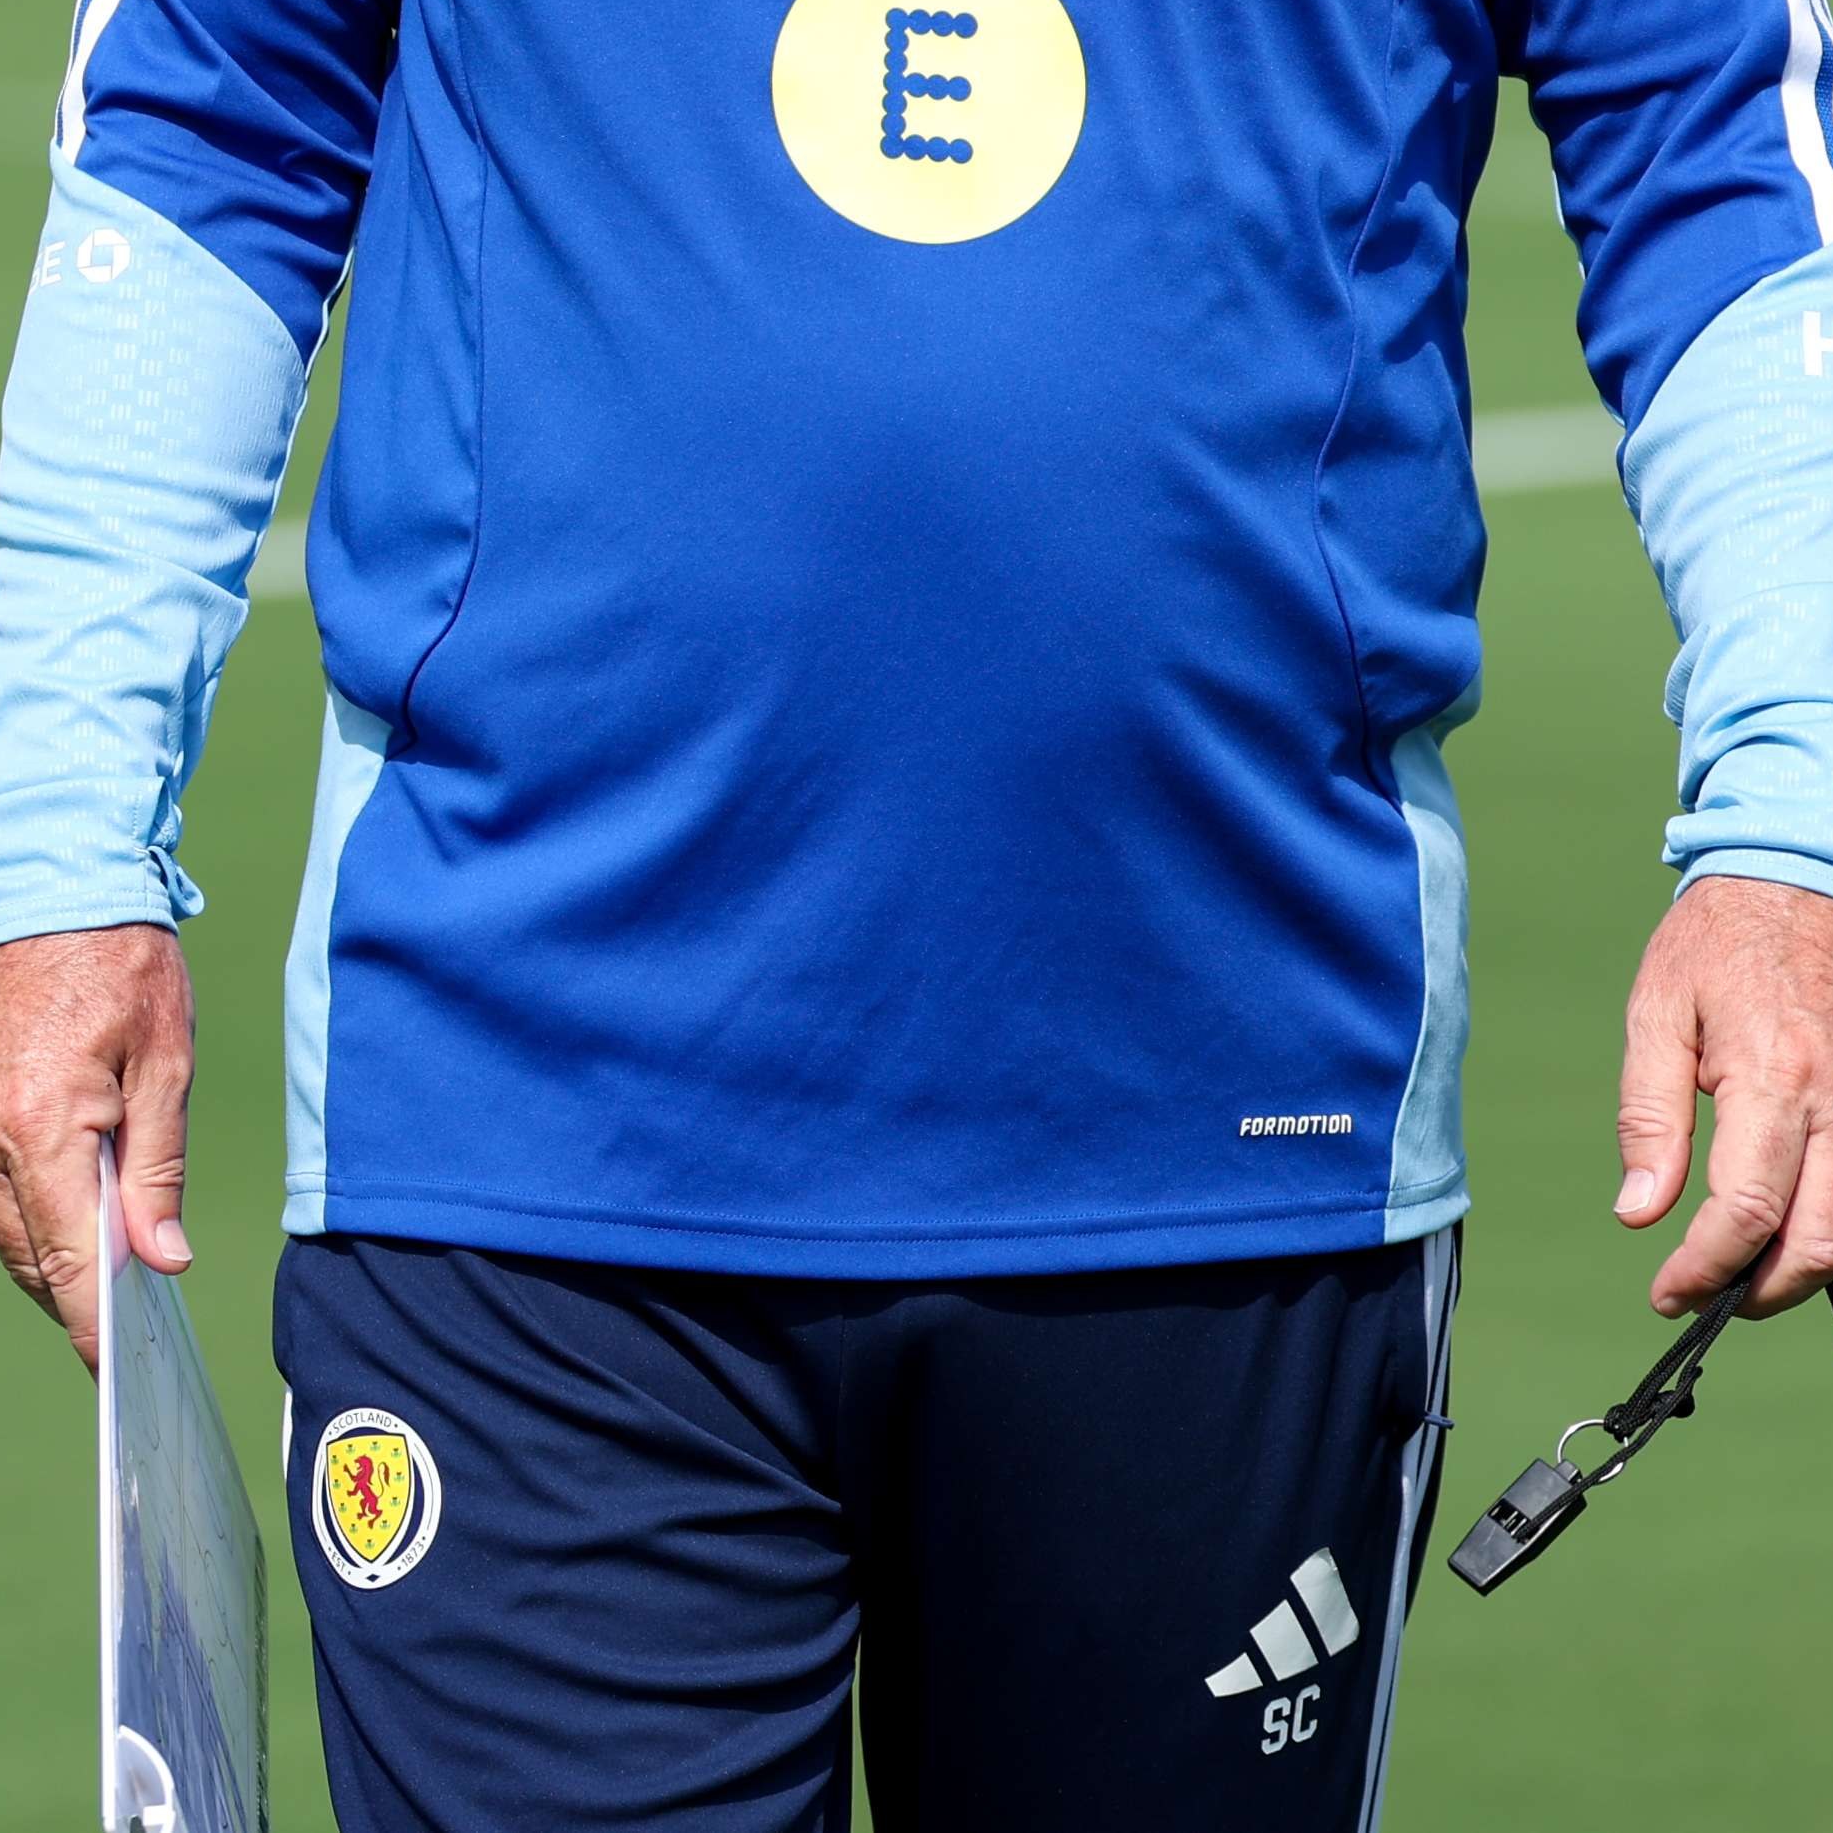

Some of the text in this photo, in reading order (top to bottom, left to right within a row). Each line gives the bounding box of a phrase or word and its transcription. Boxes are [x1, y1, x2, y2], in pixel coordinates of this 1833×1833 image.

[1239, 1114, 1352, 1137] FORMOTION
[333, 1412, 392, 1433] SCOTLAND
[330, 1551, 346, 1572] EST
[401, 1541, 424, 1567] 1873
[1261, 1683, 1321, 1755] SC
